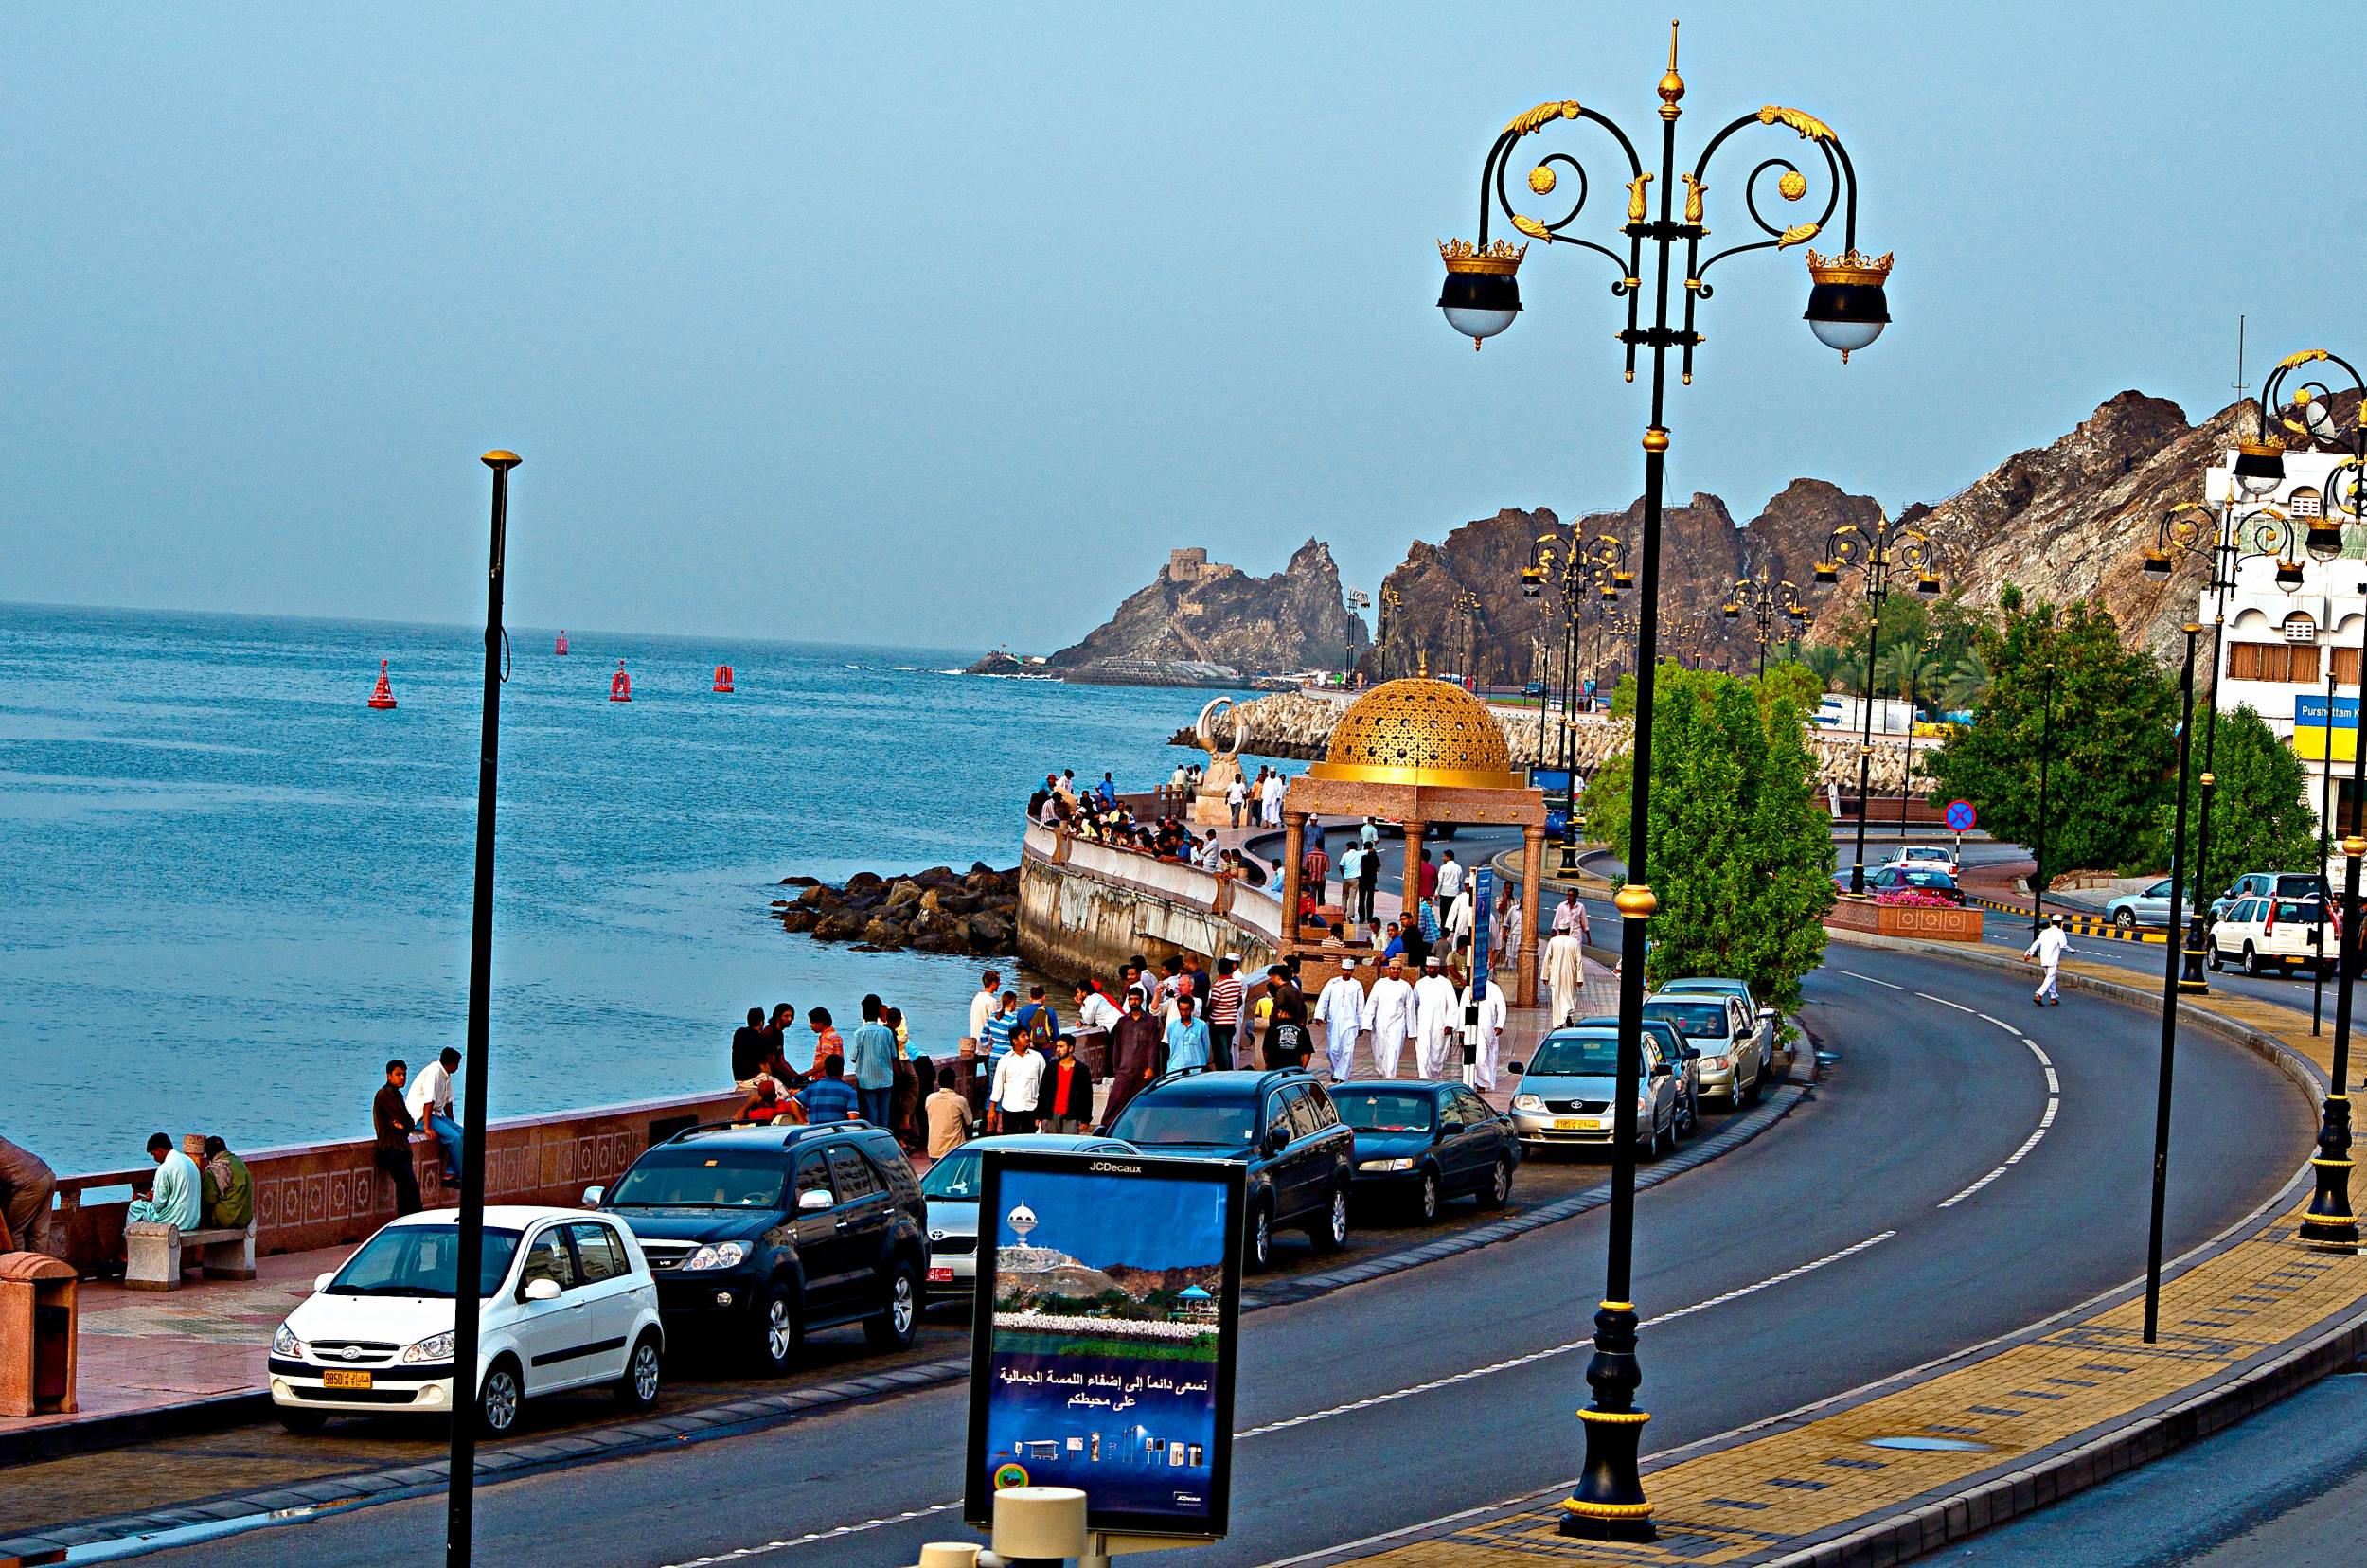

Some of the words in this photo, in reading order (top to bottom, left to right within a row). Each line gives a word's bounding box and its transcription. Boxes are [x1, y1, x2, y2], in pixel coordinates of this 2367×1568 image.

[2302, 705, 2352, 718] Purshttam
[1089, 1161, 1142, 1173] JCDecaux
[325, 1372, 343, 1385] 9850
[999, 1367, 1043, 1386] الجمالية
[1046, 1370, 1083, 1385] اللمسة
[1087, 1375, 1122, 1391] إضفاء
[1125, 1375, 1143, 1392] إلى
[1175, 1380, 1207, 1395] نسعى
[1067, 1394, 1111, 1409] محيطكم
[1112, 1395, 1136, 1411] على
